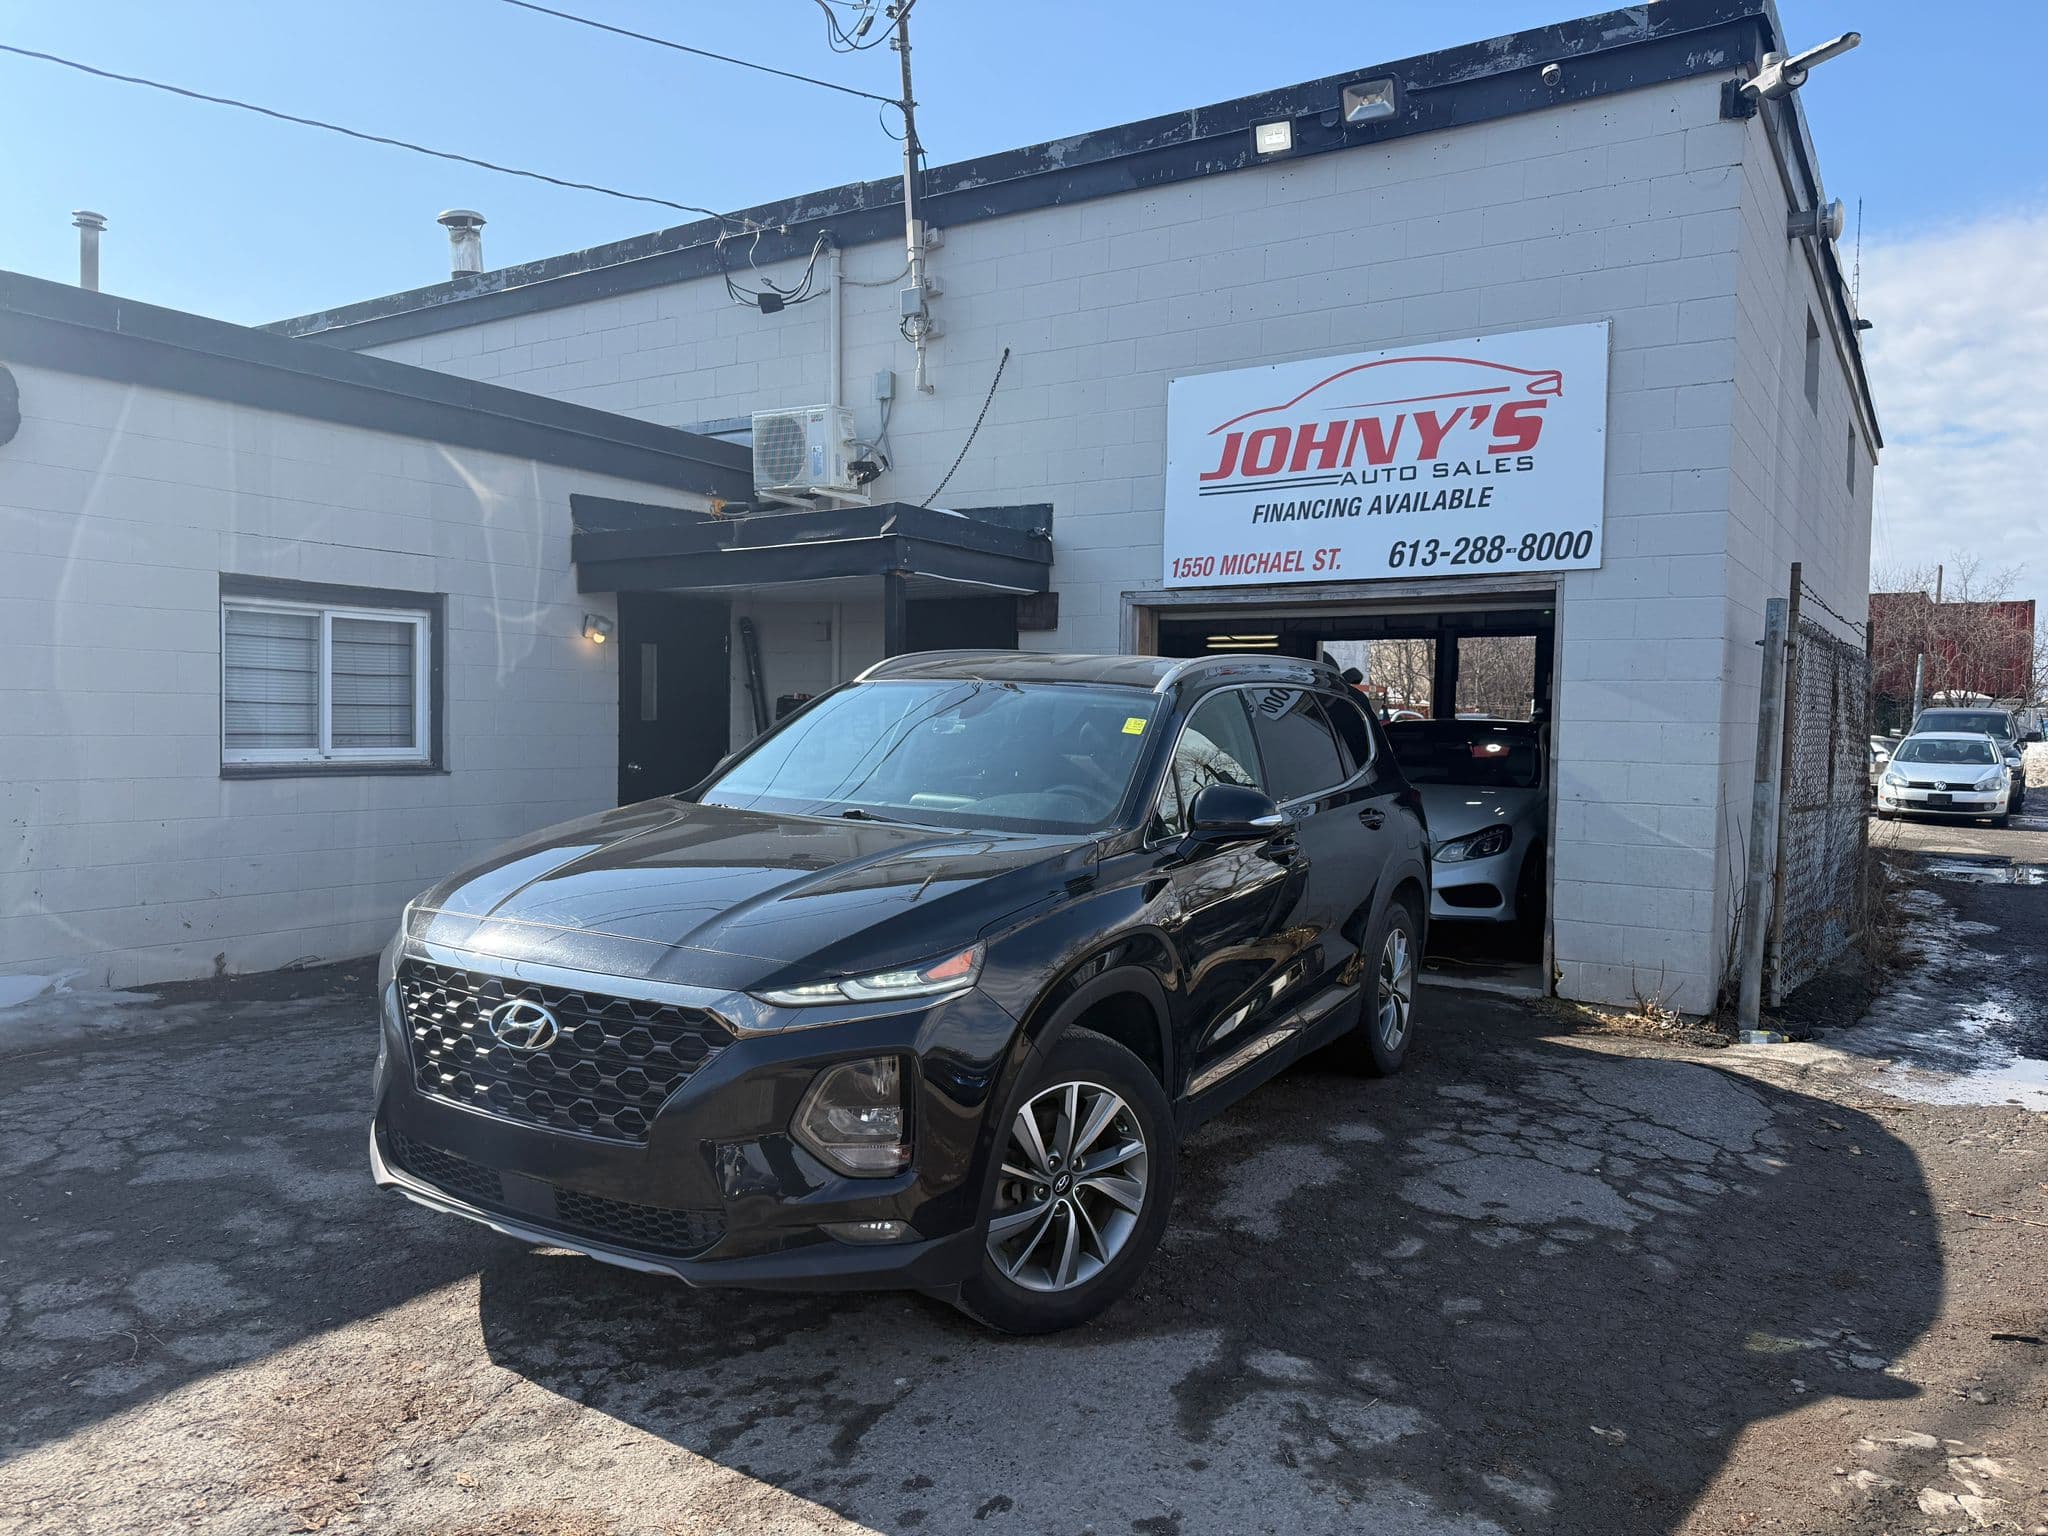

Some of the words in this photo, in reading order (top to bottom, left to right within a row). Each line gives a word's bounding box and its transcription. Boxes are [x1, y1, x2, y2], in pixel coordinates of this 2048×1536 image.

[1200, 399, 1547, 482] JOHNY'S
[1340, 466, 1417, 486] AUTO
[1432, 456, 1534, 478] SALES
[1252, 497, 1363, 524] FINANCING
[1367, 487, 1493, 515] AVAILABLE
[1172, 556, 1215, 579] 1550
[1219, 551, 1305, 576] MICHAEL
[1313, 548, 1341, 571] ST.
[1388, 529, 1593, 568] 613-288-8000
